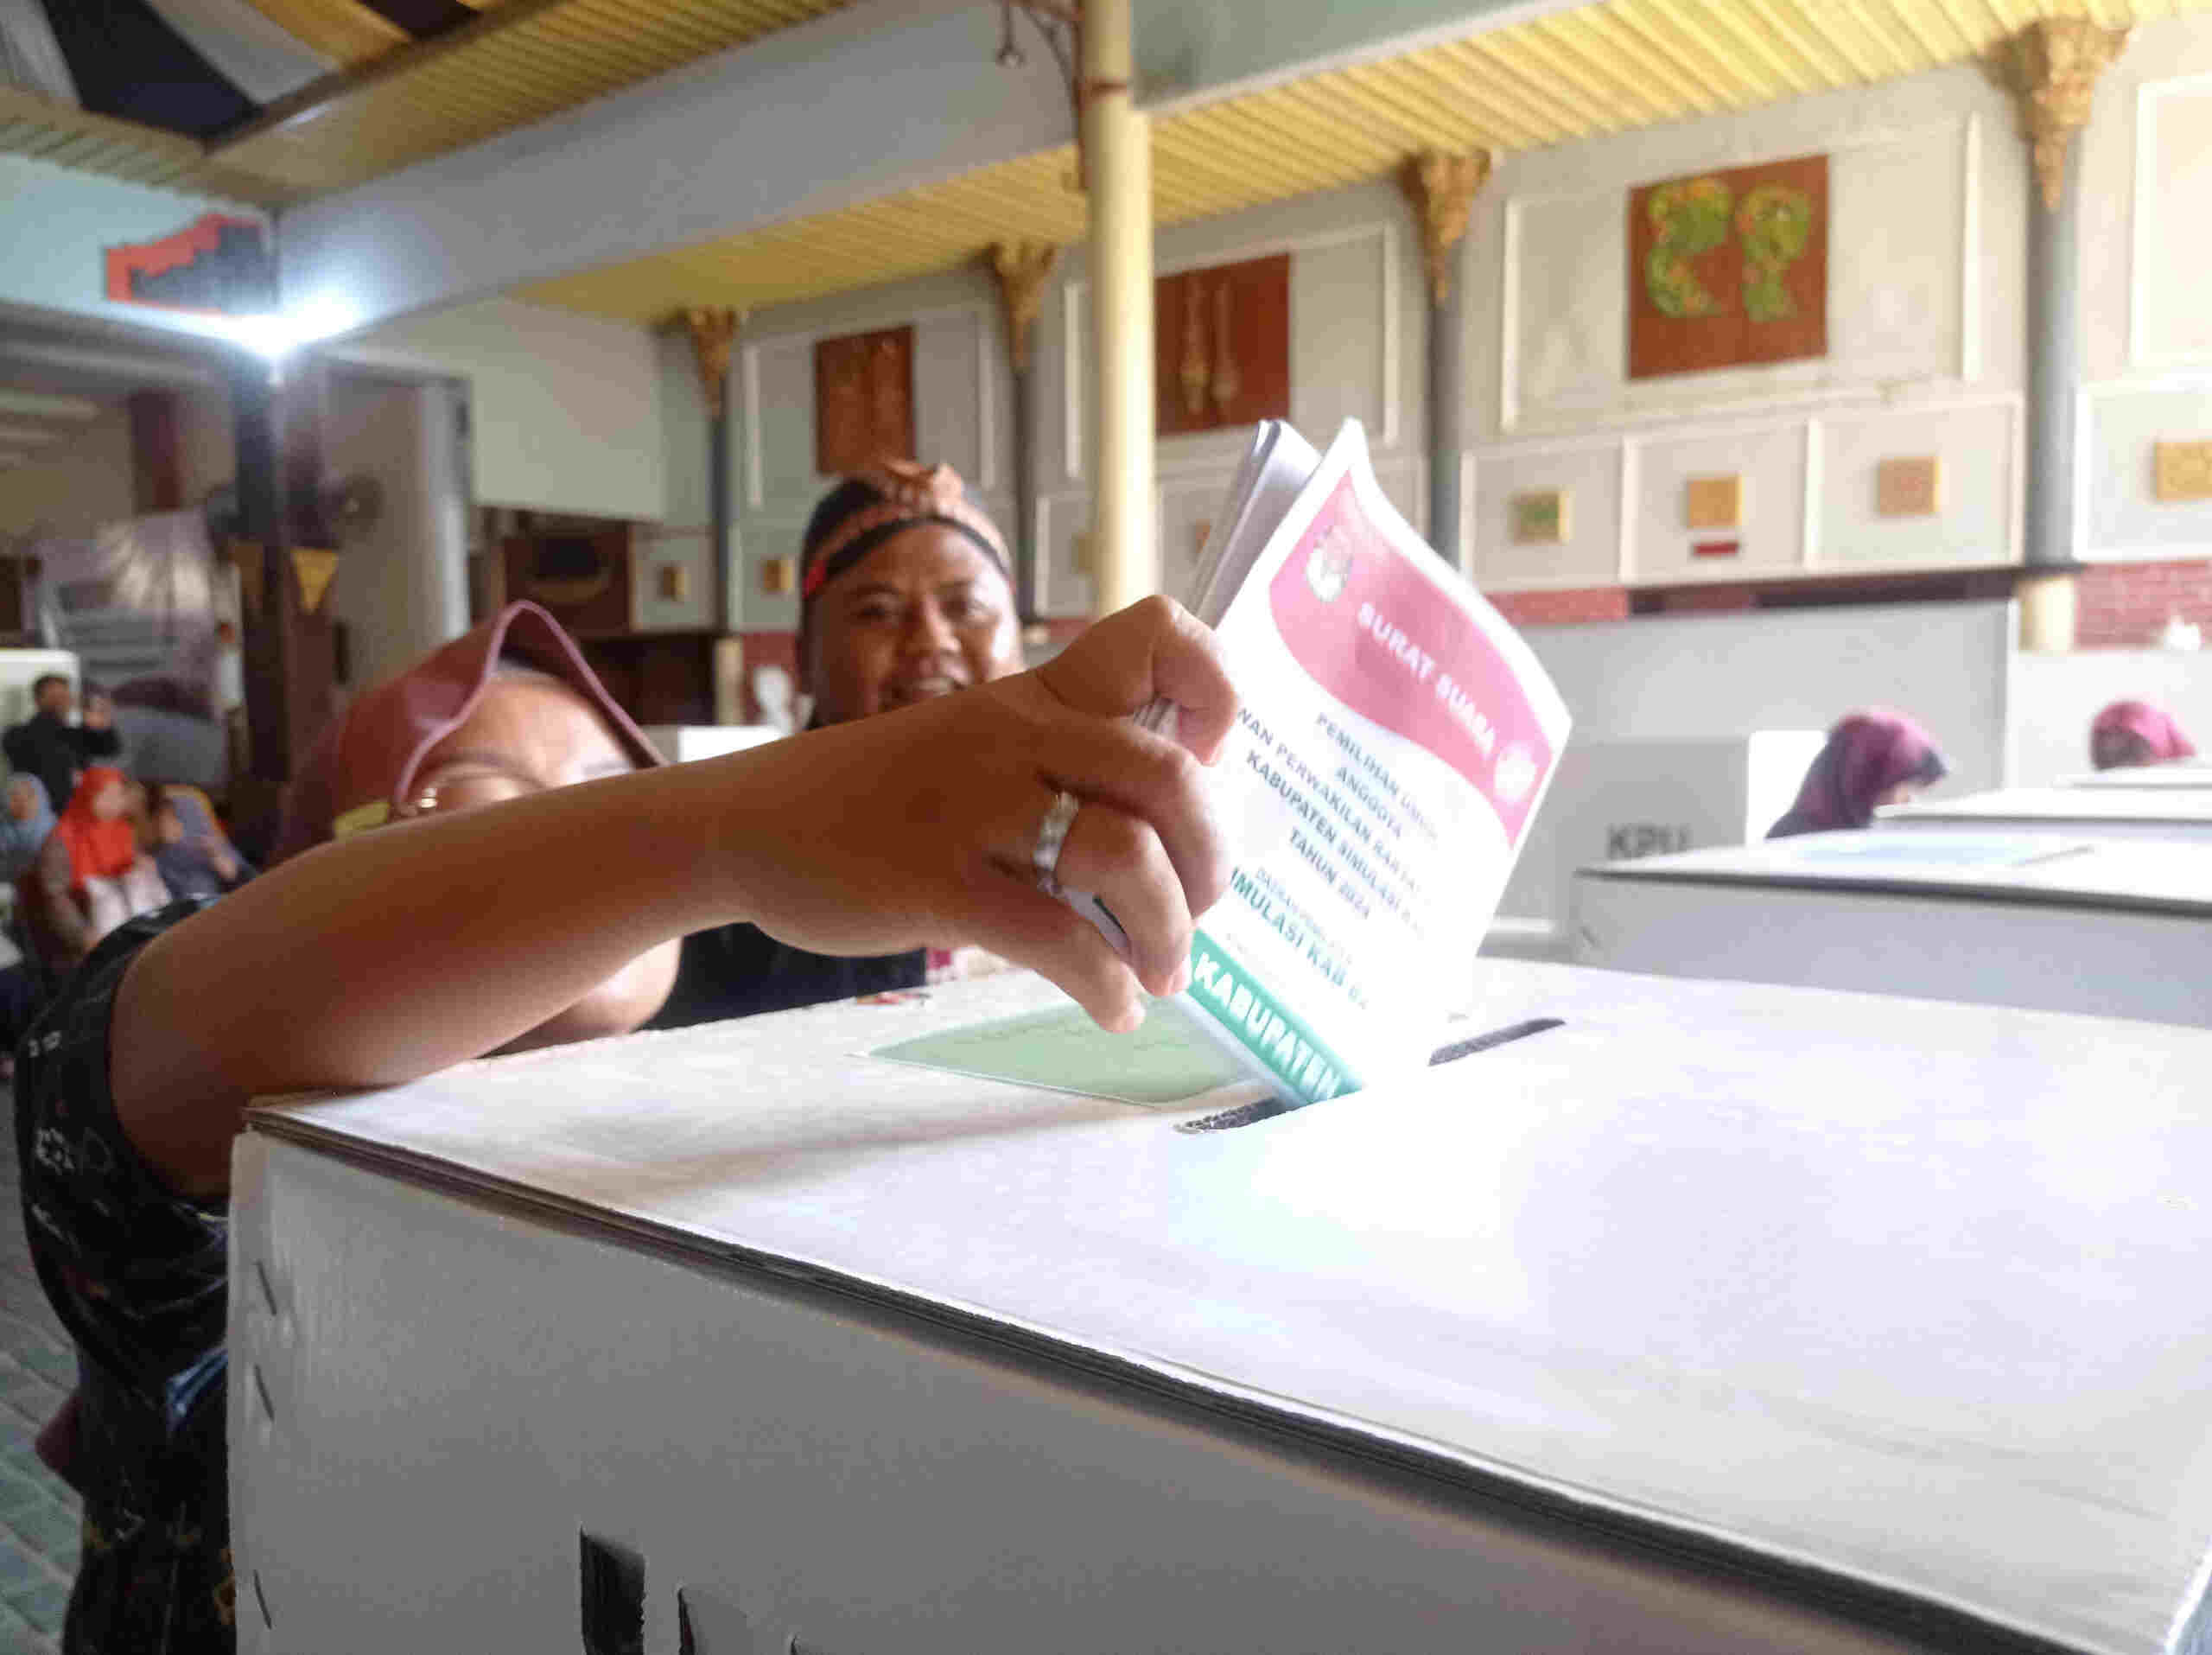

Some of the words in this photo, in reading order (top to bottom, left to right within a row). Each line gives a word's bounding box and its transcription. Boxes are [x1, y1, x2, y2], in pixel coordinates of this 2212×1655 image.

[1357, 602, 1436, 683] SURAT
[1436, 673, 1497, 755] SUARA
[1247, 748, 1337, 843] KABUPATEN
[1275, 742, 1372, 844] PERWAKILAN
[1315, 711, 1398, 797] PEMILIHAN
[1289, 825, 1338, 884] TAHUN
[1605, 823, 1691, 860] KPU
[1193, 952, 1340, 1102] KABUPATEN
